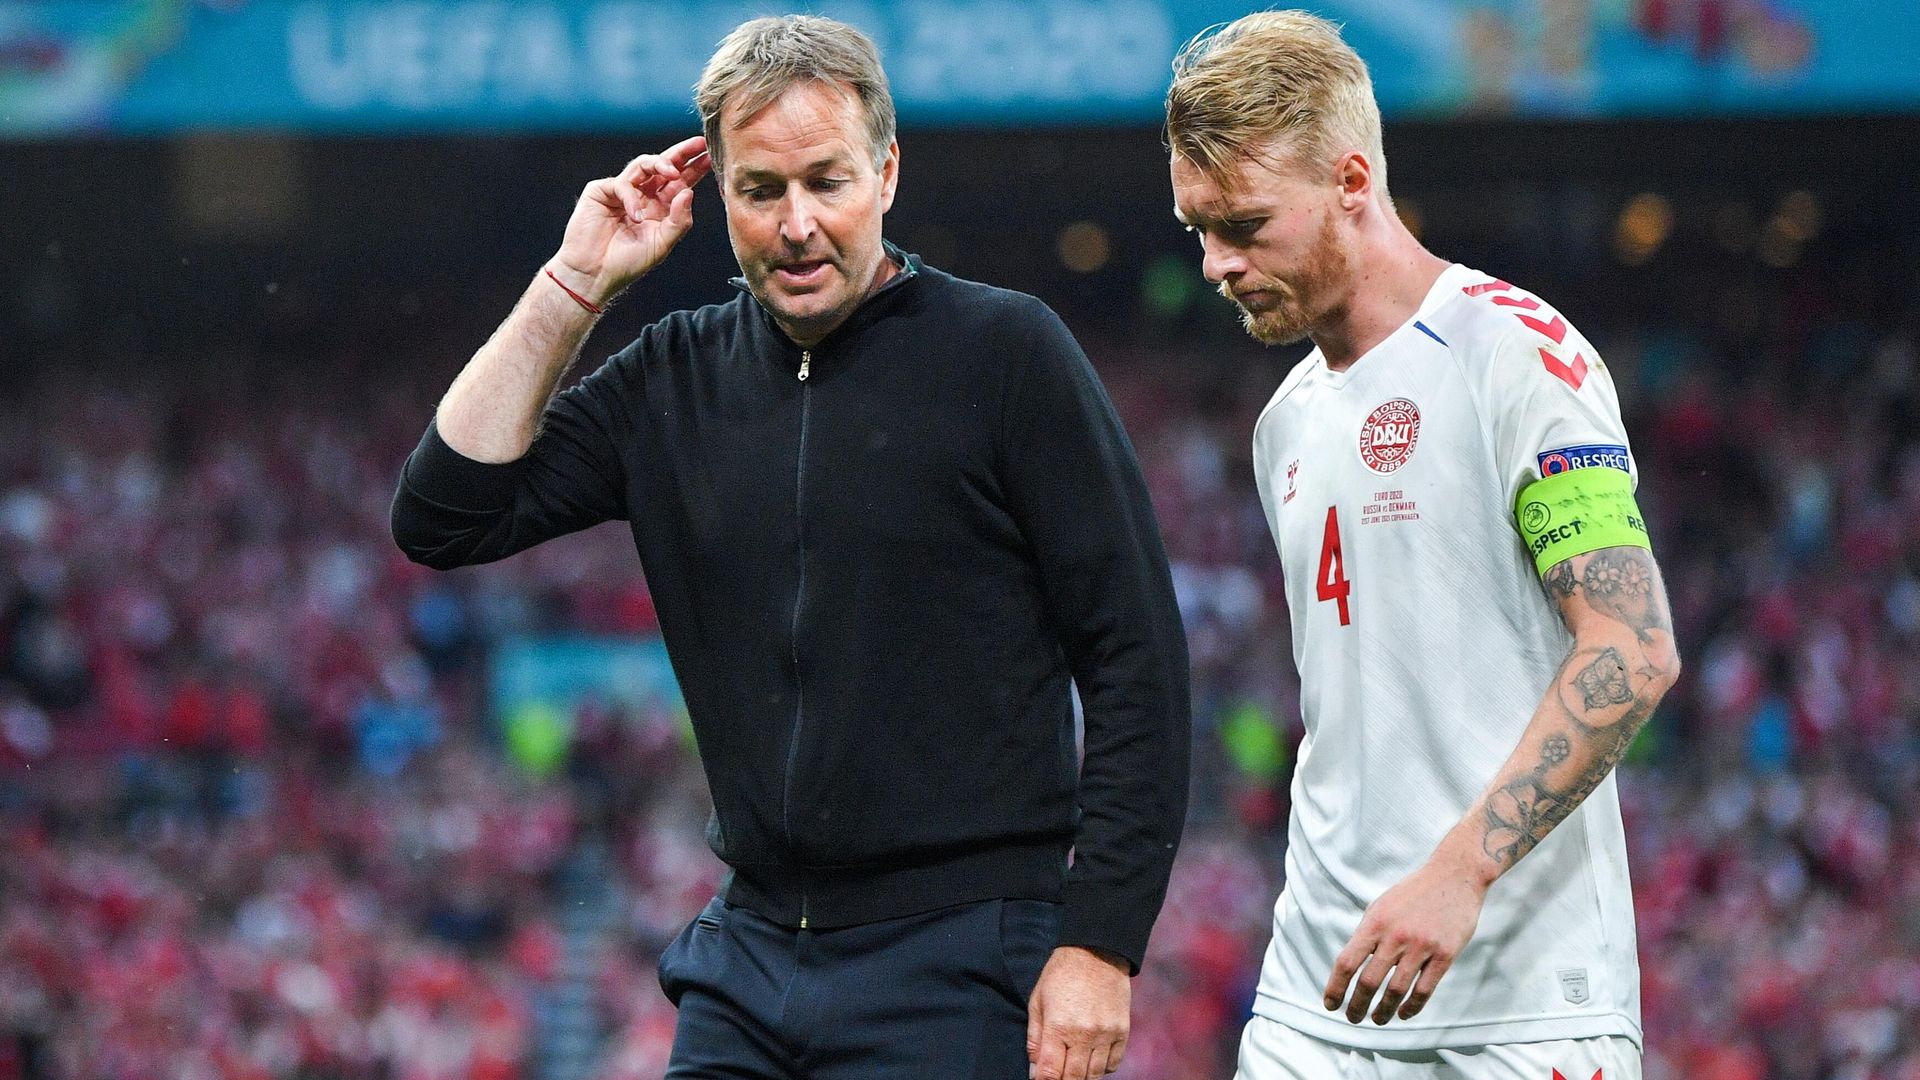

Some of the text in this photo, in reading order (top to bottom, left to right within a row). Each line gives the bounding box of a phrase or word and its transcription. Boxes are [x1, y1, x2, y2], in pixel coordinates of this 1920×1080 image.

[288, 7, 572, 108] UEFA
[1372, 423, 1410, 446] DBU
[1360, 422, 1374, 465] DANSK
[1375, 461, 1402, 472] 1889
[1571, 454, 1629, 470] RESPECT
[1374, 490, 1403, 502] EURO 2020
[1363, 504, 1381, 515] RUSSIA
[1388, 501, 1416, 512] DENMARK
[1391, 513, 1420, 522] COPENHAGEN
[1316, 505, 1350, 627] 4
